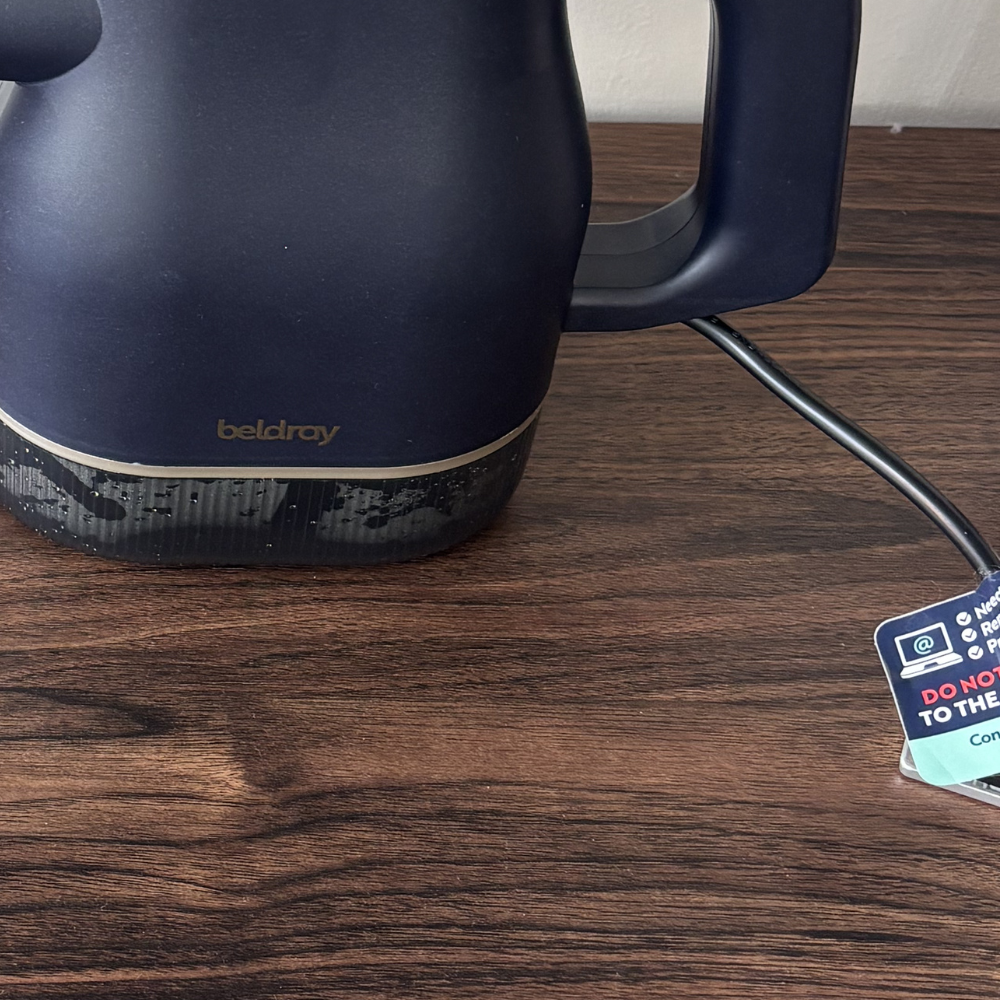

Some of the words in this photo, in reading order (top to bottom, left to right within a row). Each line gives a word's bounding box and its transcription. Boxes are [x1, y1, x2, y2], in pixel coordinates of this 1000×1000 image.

[217, 419, 340, 446] beldray
[921, 683, 957, 705] DO
[918, 706, 952, 727] TO
[953, 690, 1000, 717] THE
